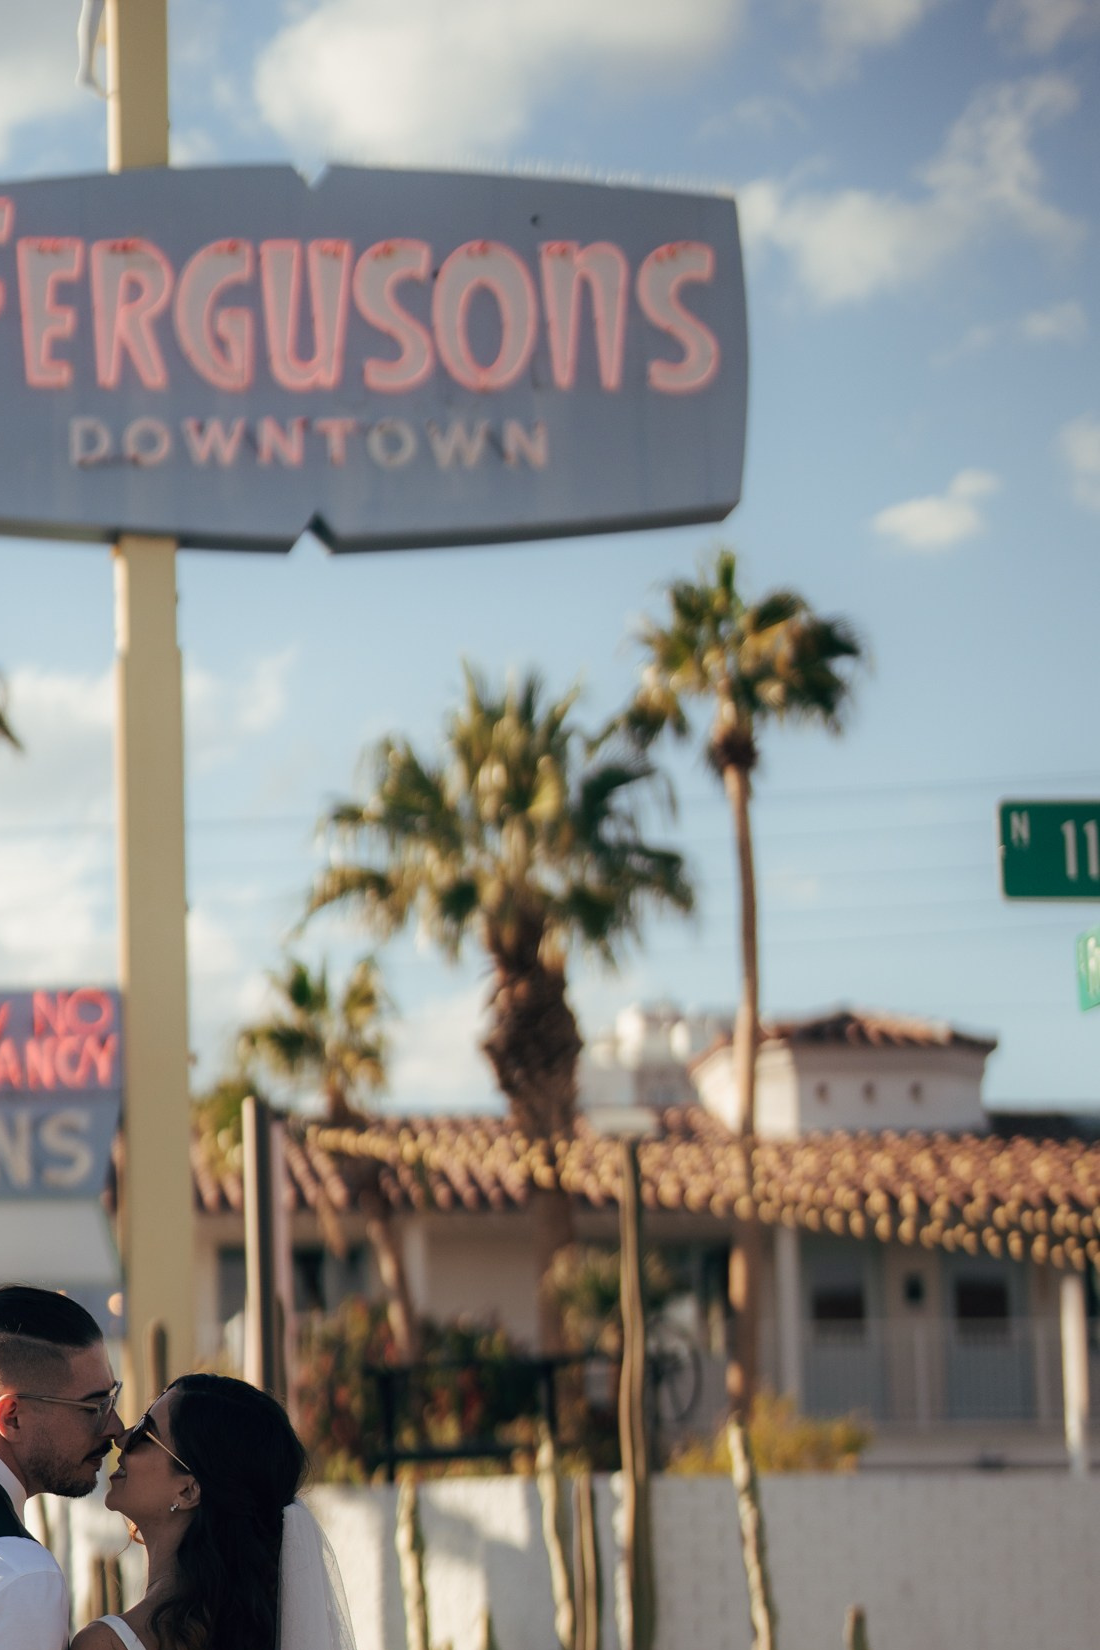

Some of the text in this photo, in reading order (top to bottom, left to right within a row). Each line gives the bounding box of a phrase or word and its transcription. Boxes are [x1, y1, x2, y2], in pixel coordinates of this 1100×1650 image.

[69, 414, 550, 469] DOWNTOWN
[1009, 810, 1030, 848] N
[32, 988, 114, 1037] NO
